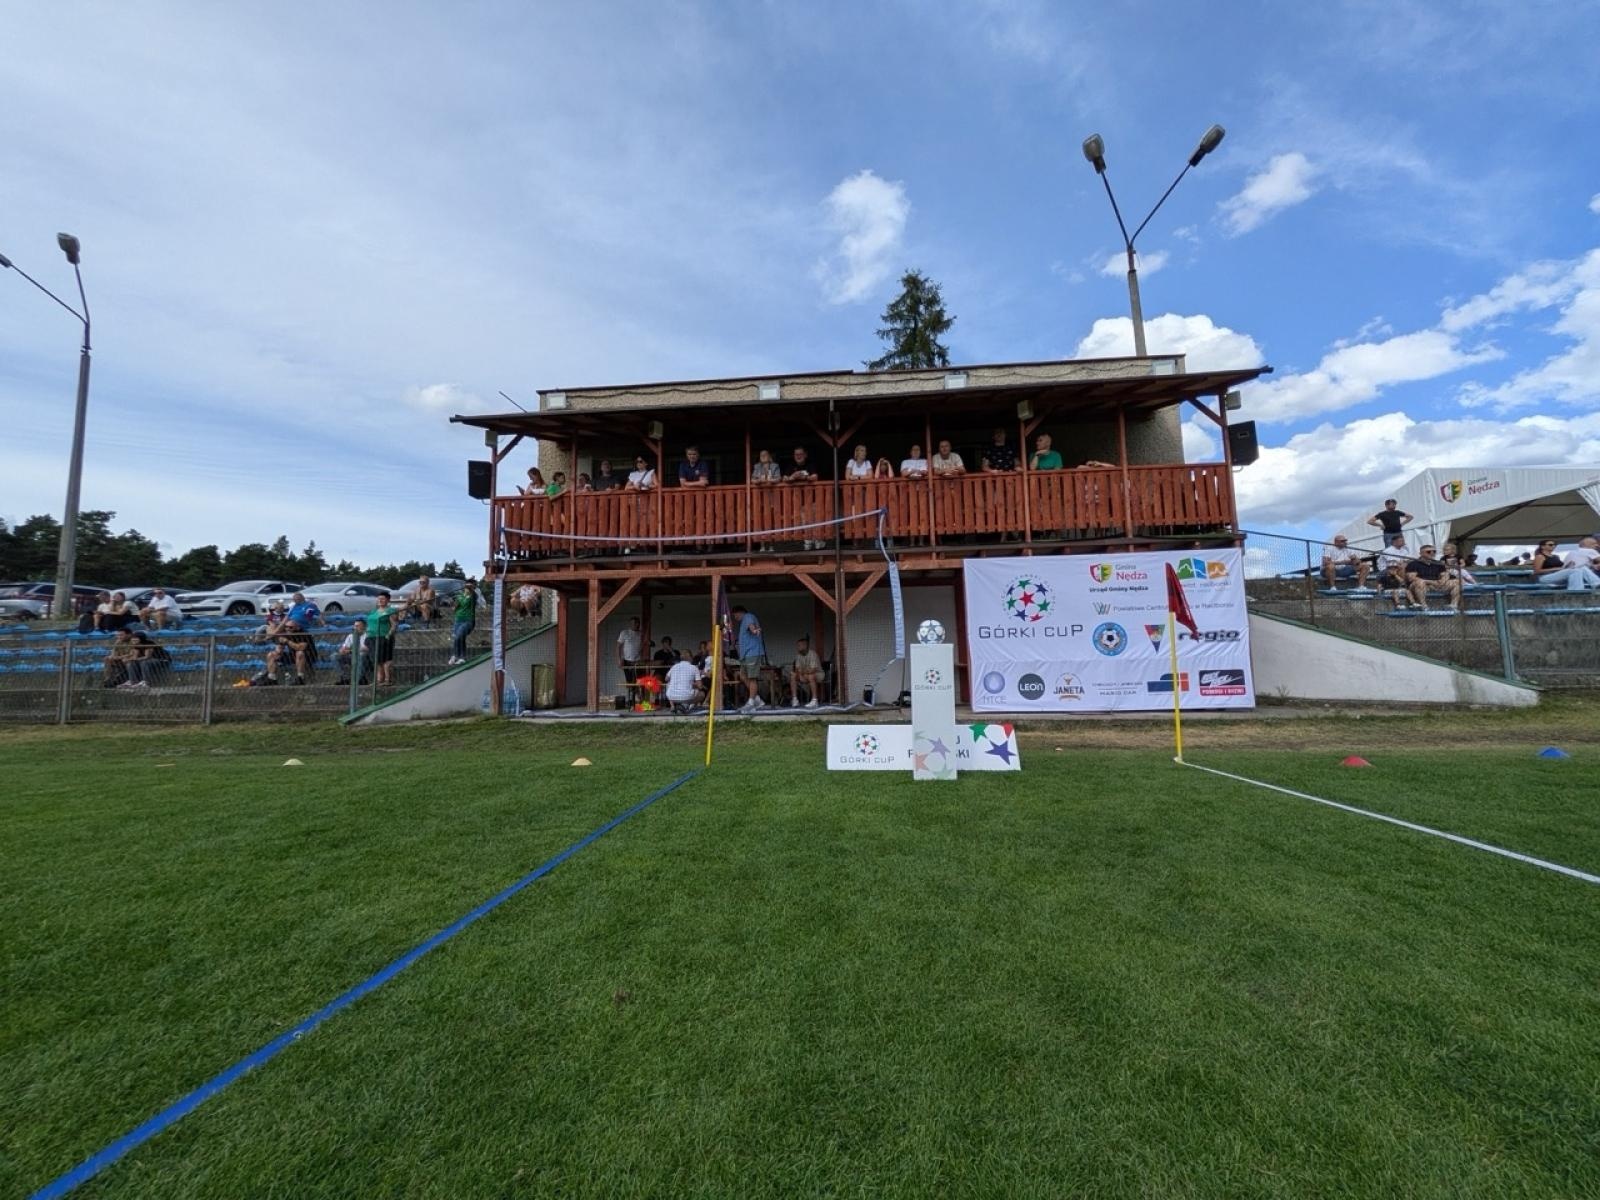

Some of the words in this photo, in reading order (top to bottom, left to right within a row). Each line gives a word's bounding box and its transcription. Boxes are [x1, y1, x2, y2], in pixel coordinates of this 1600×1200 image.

[1468, 481, 1501, 495] Nędza
[1116, 571, 1148, 581] Nędza
[978, 625, 1036, 639] GÓRKI
[1044, 624, 1084, 637] CUP
[1019, 683, 1044, 691] LEON
[1053, 686, 1085, 695] JANETA
[839, 755, 871, 764] GÓRKI
[874, 755, 895, 764] CUP
